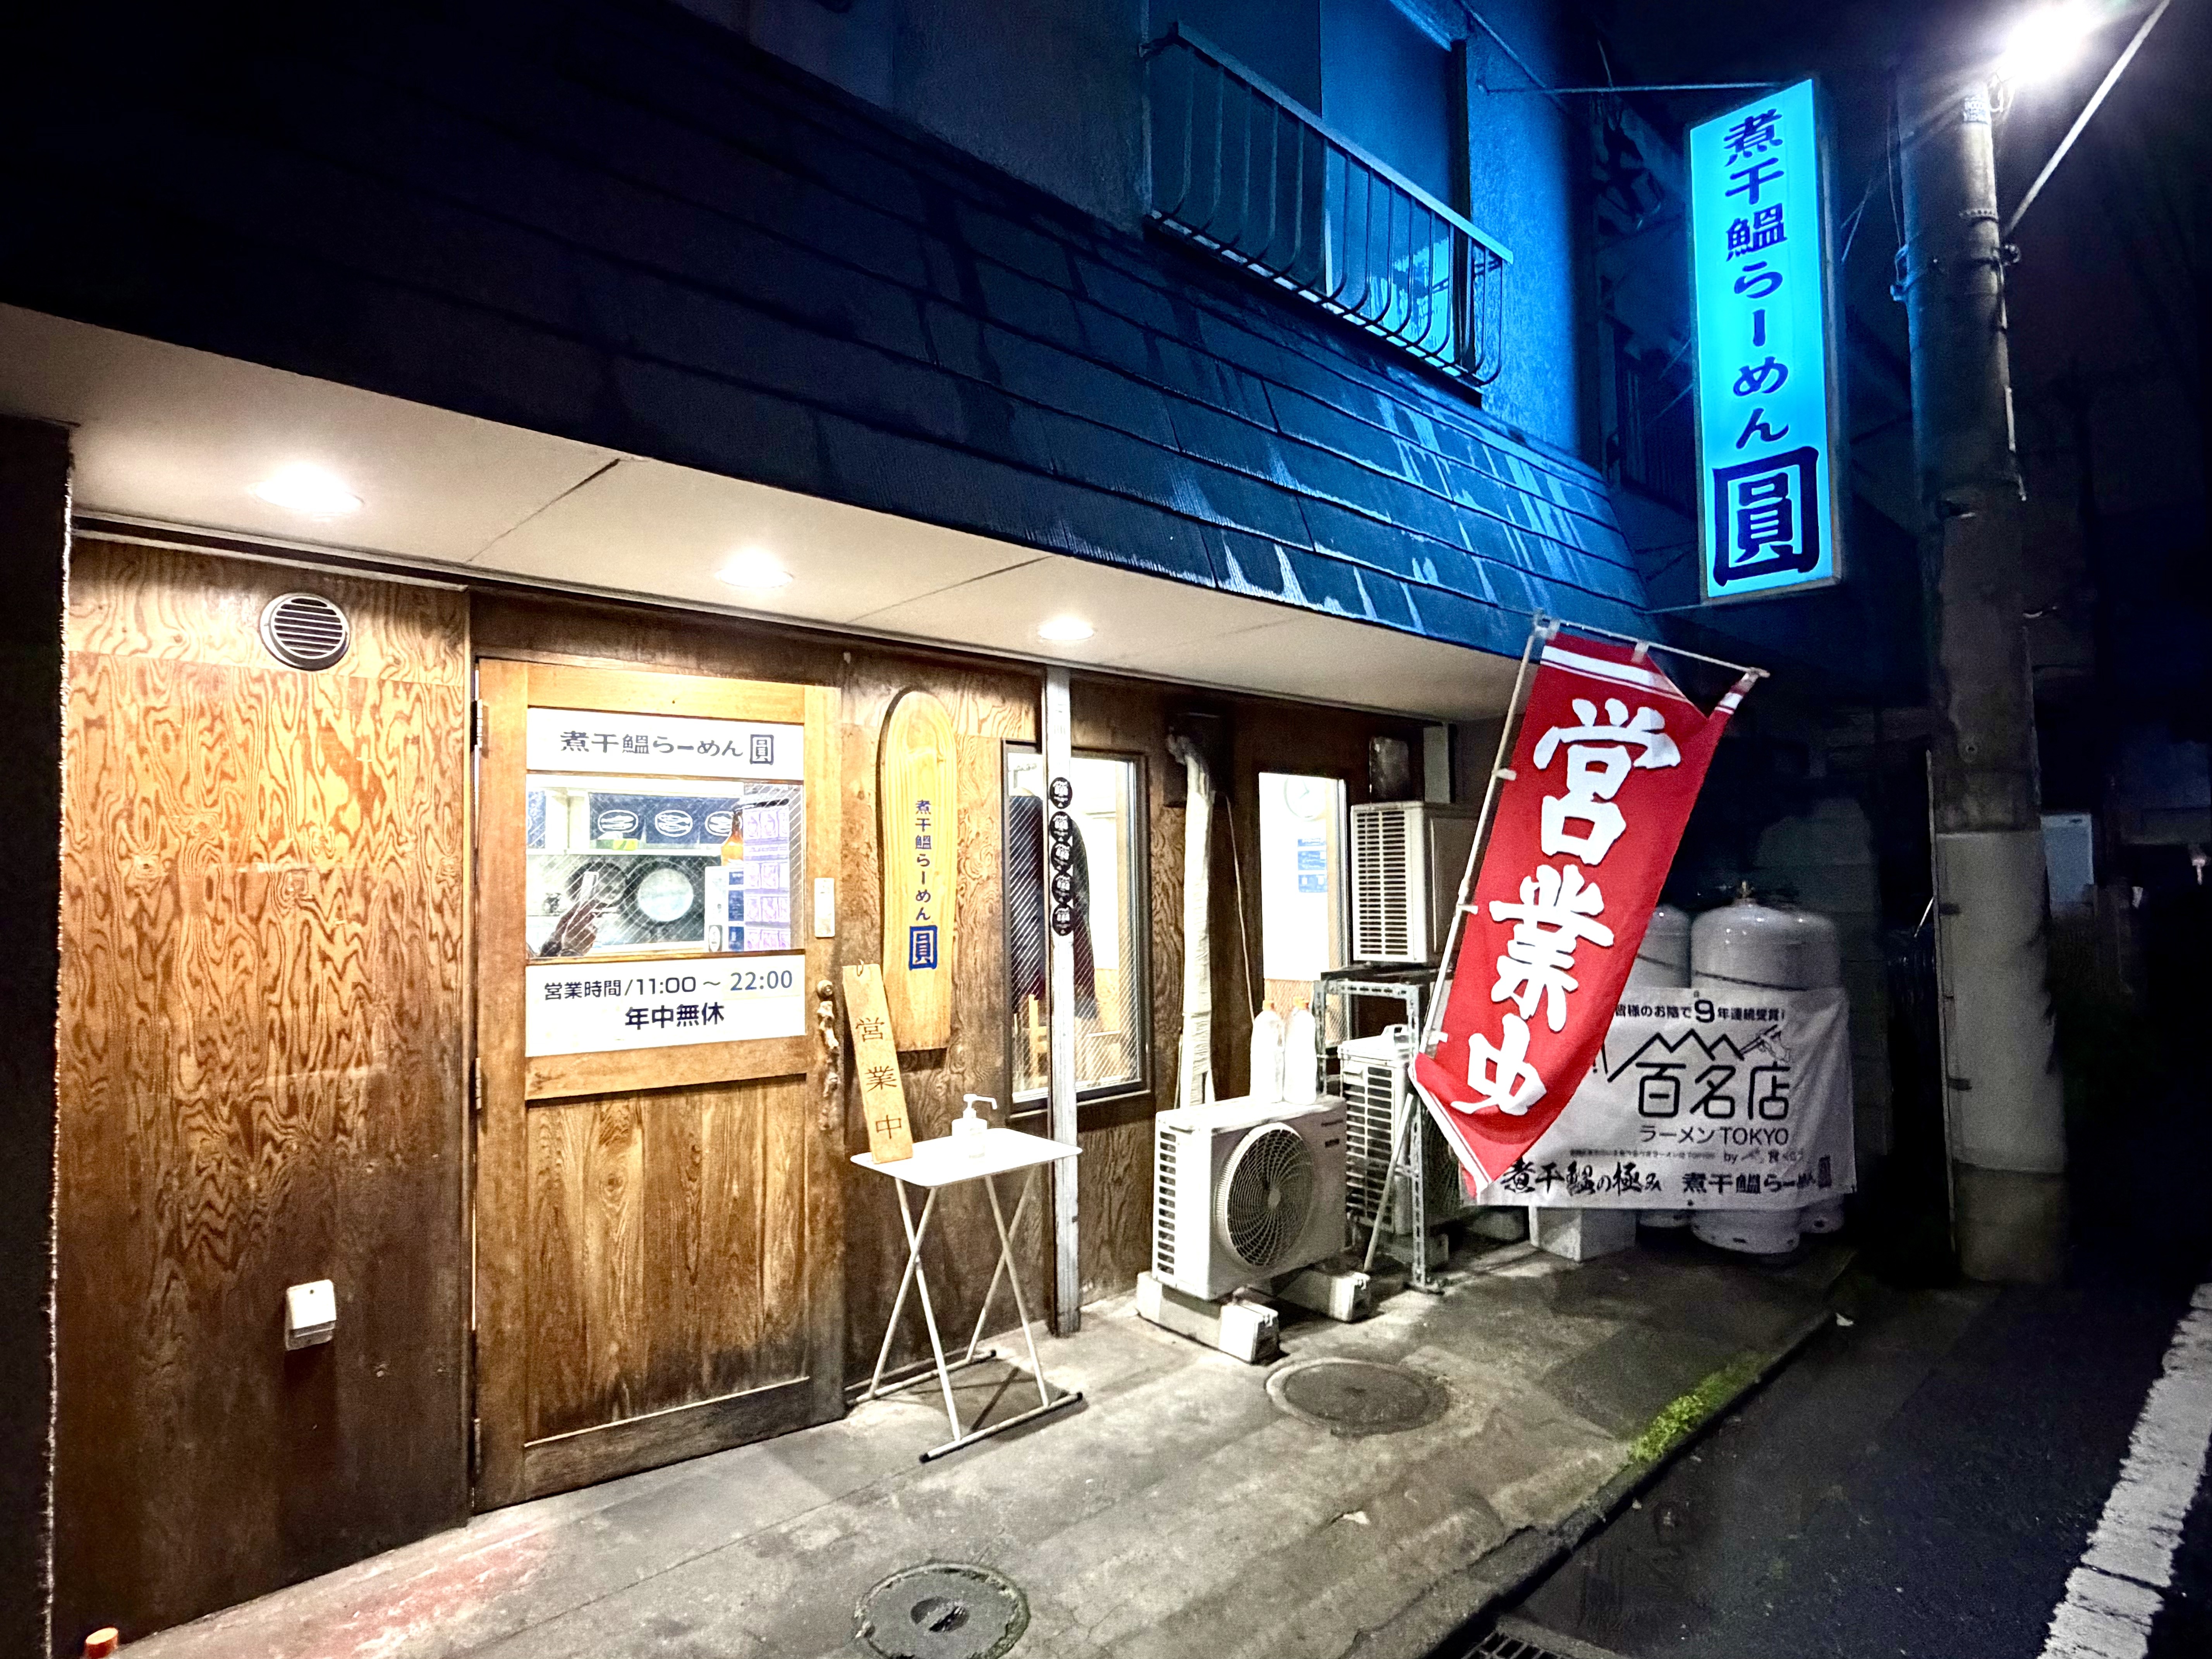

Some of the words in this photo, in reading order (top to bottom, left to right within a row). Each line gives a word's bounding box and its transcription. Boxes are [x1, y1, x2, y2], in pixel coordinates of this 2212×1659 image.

[1450, 698, 1681, 1115] 営業中
[730, 970, 793, 991] 22:00
[625, 1002, 725, 1030] 年中無休
[855, 1017, 902, 1139] 営業中
[1635, 1061, 1790, 1120] 百名店
[1724, 1149, 1738, 1164] by
